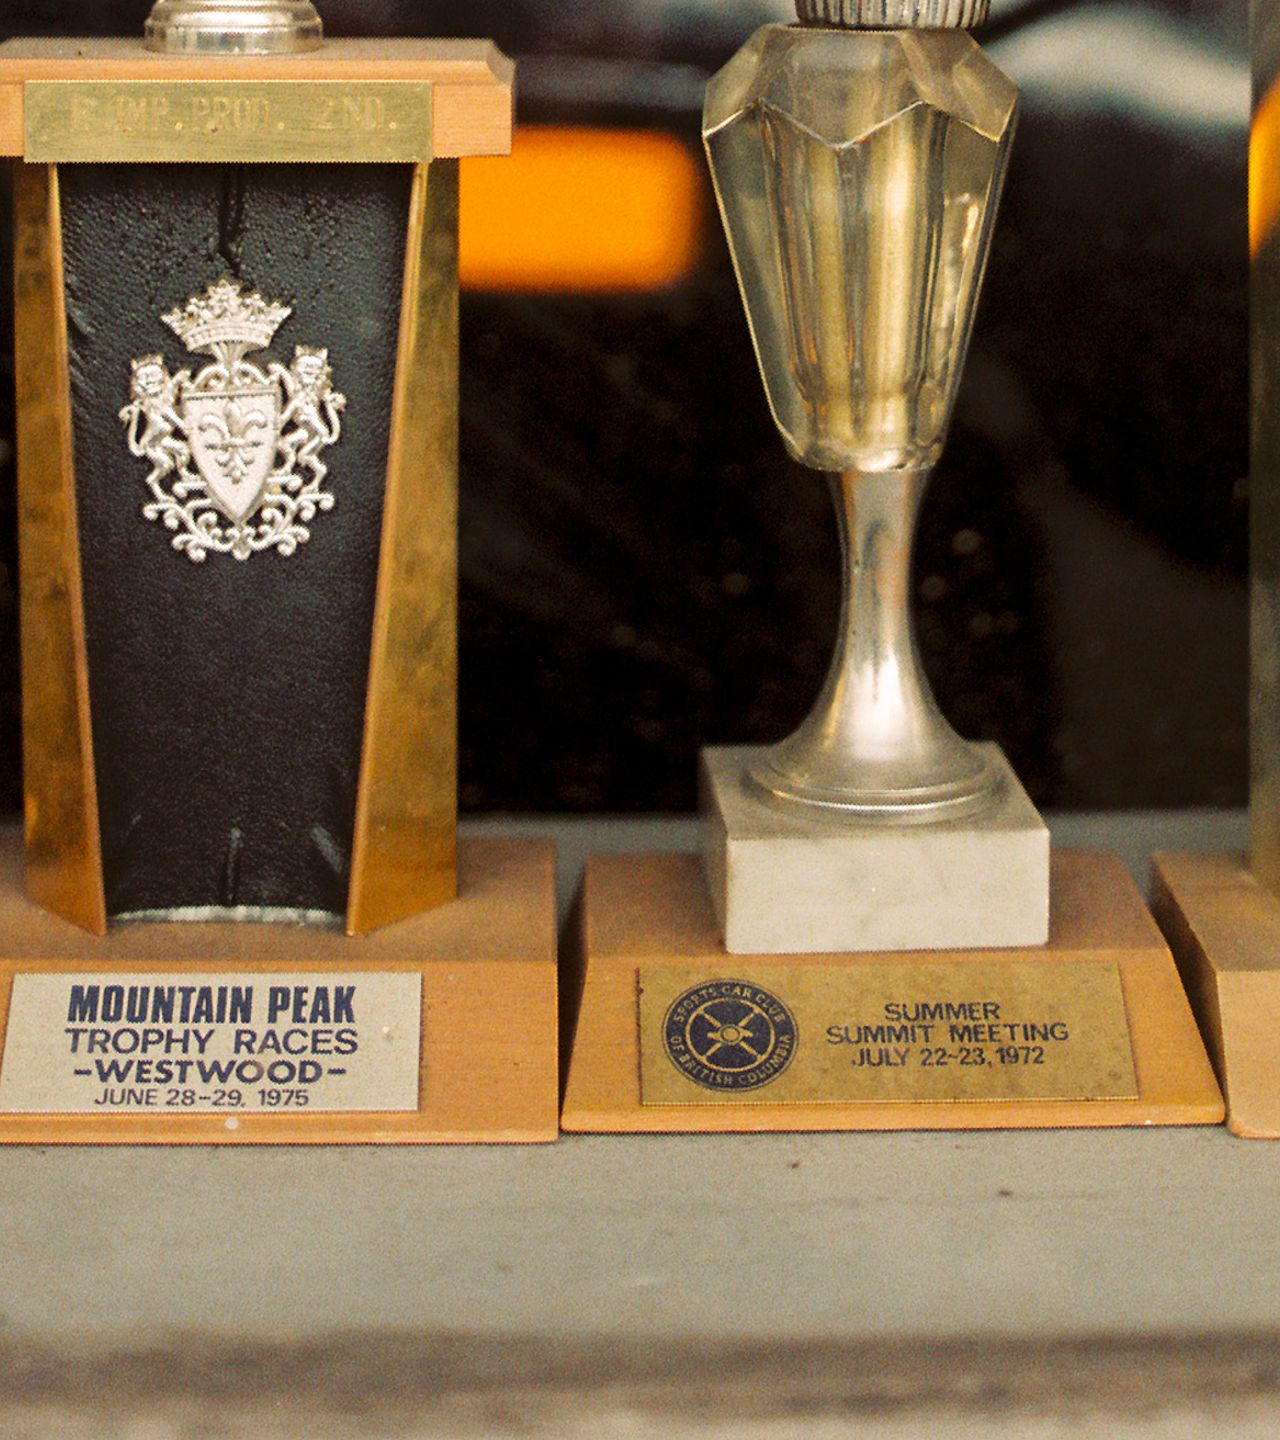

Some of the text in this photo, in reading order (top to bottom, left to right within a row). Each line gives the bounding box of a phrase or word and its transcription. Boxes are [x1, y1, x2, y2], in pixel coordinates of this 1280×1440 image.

[67, 985, 356, 1024] MOUNTAIN PEAK
[673, 986, 787, 1023] SPORTS CAR CLUB
[884, 1001, 1001, 1022] SUMMER
[64, 1027, 359, 1055] TROPHY RACES
[826, 1022, 1069, 1044] SUMMIT MEETING
[670, 1034, 793, 1086] OF BRITISH COLUMBIA
[852, 1047, 910, 1067] JULY
[94, 1088, 158, 1106] JUNE
[257, 1088, 310, 1107] 1975
